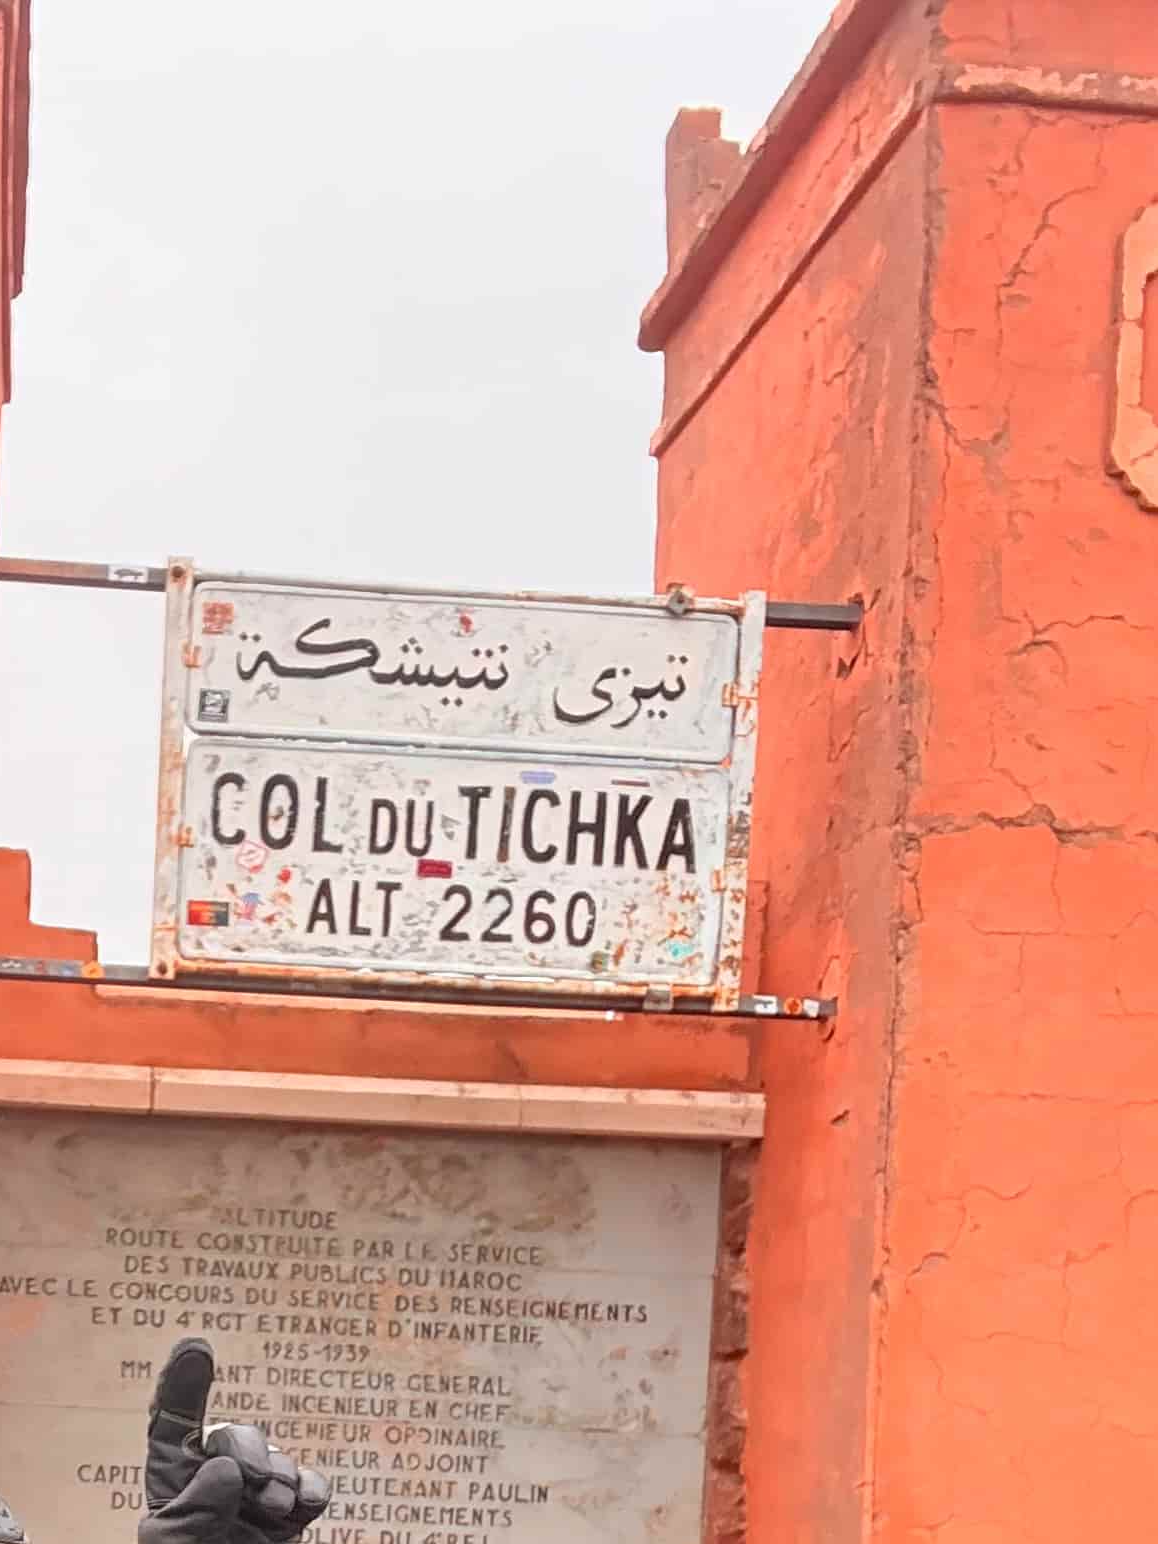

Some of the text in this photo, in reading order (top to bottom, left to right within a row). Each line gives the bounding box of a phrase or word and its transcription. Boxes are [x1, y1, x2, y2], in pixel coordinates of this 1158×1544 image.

[210, 771, 697, 874] COL DU TICHKA
[306, 878, 598, 947] ALT 2260
[105, 1226, 184, 1249] ROUTE
[353, 1238, 395, 1259] PAR
[405, 1240, 437, 1262] LE
[447, 1243, 544, 1266] SERVICE
[124, 1255, 523, 1292] DES TRAVAUX PUBLICS DU MAROC
[67, 1279, 98, 1297] LE
[109, 1281, 235, 1305] CONCOURS
[246, 1287, 278, 1306] DU
[290, 1290, 380, 1311] SERVICE
[395, 1295, 439, 1314] DES
[450, 1296, 648, 1324] RENSEIGNEMENTS
[92, 1306, 122, 1325] ET
[133, 1308, 165, 1328] DU
[202, 1312, 248, 1332] RGT
[257, 1314, 377, 1338] ETRANGER
[267, 1367, 395, 1392] DIRECTEUR
[407, 1374, 511, 1397] GENERAL
[408, 1401, 438, 1420] EN
[449, 1402, 511, 1423] CHEF
[298, 1449, 380, 1470] ENIEUR
[76, 1464, 550, 1503] CAPIT IEUTENANT PAULIN
[327, 1503, 514, 1528] ENSEIGNEMENTS
